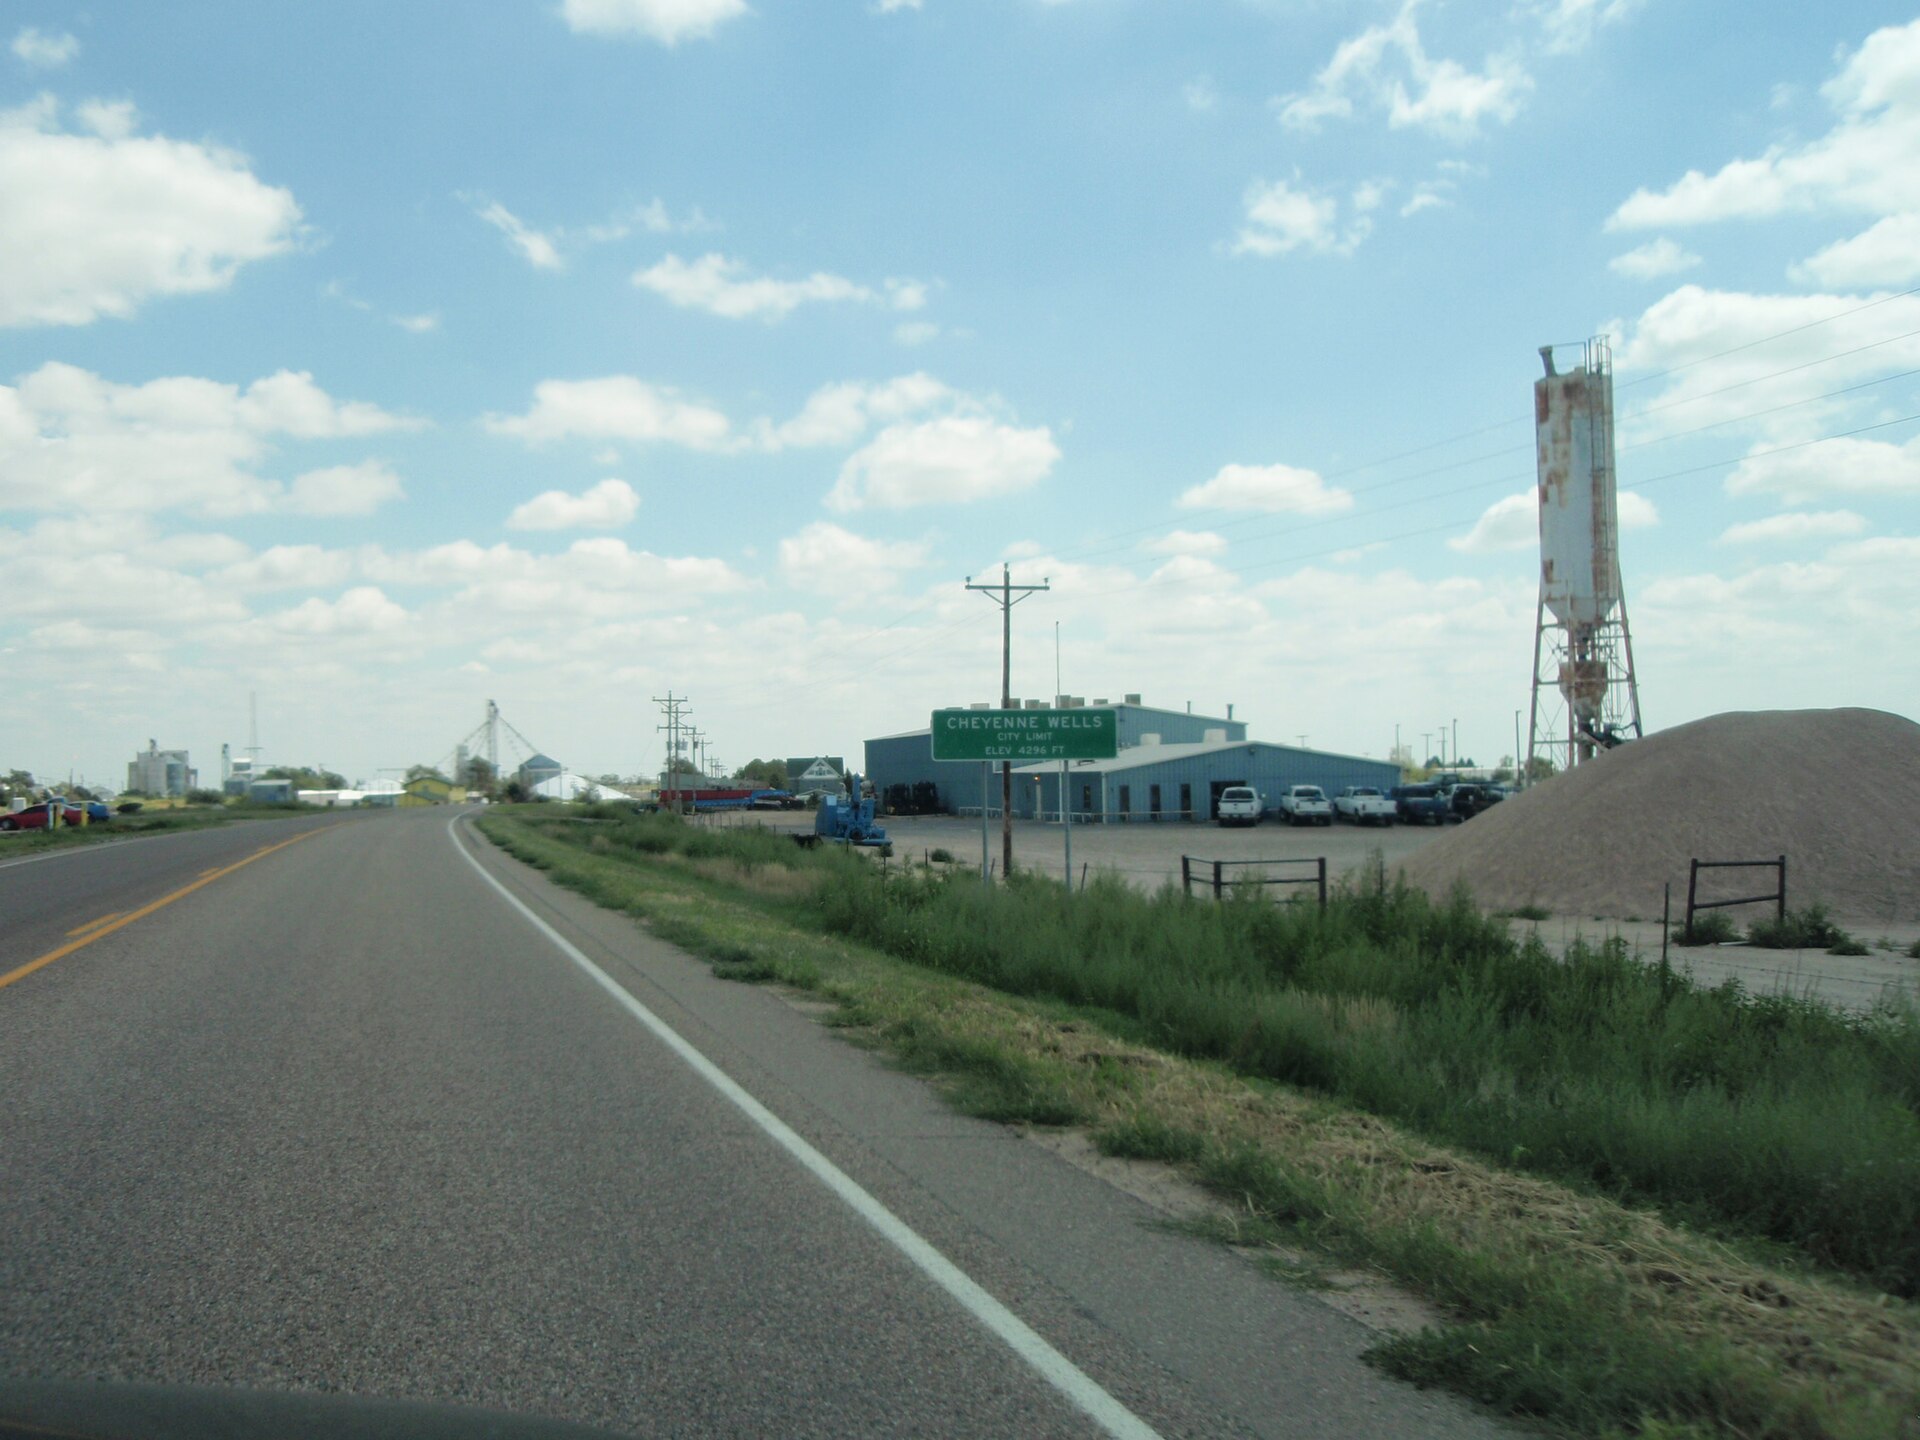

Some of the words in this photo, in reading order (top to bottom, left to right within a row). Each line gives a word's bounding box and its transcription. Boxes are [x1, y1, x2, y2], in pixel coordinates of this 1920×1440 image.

[947, 717, 1039, 729] CHEYENNE
[1047, 716, 1103, 728] WELLS
[997, 732, 1020, 741] CITY
[1026, 732, 1053, 740] LIMIT
[985, 746, 1012, 755] ELEV
[1018, 746, 1047, 755] 4296
[1051, 745, 1065, 754] FT
